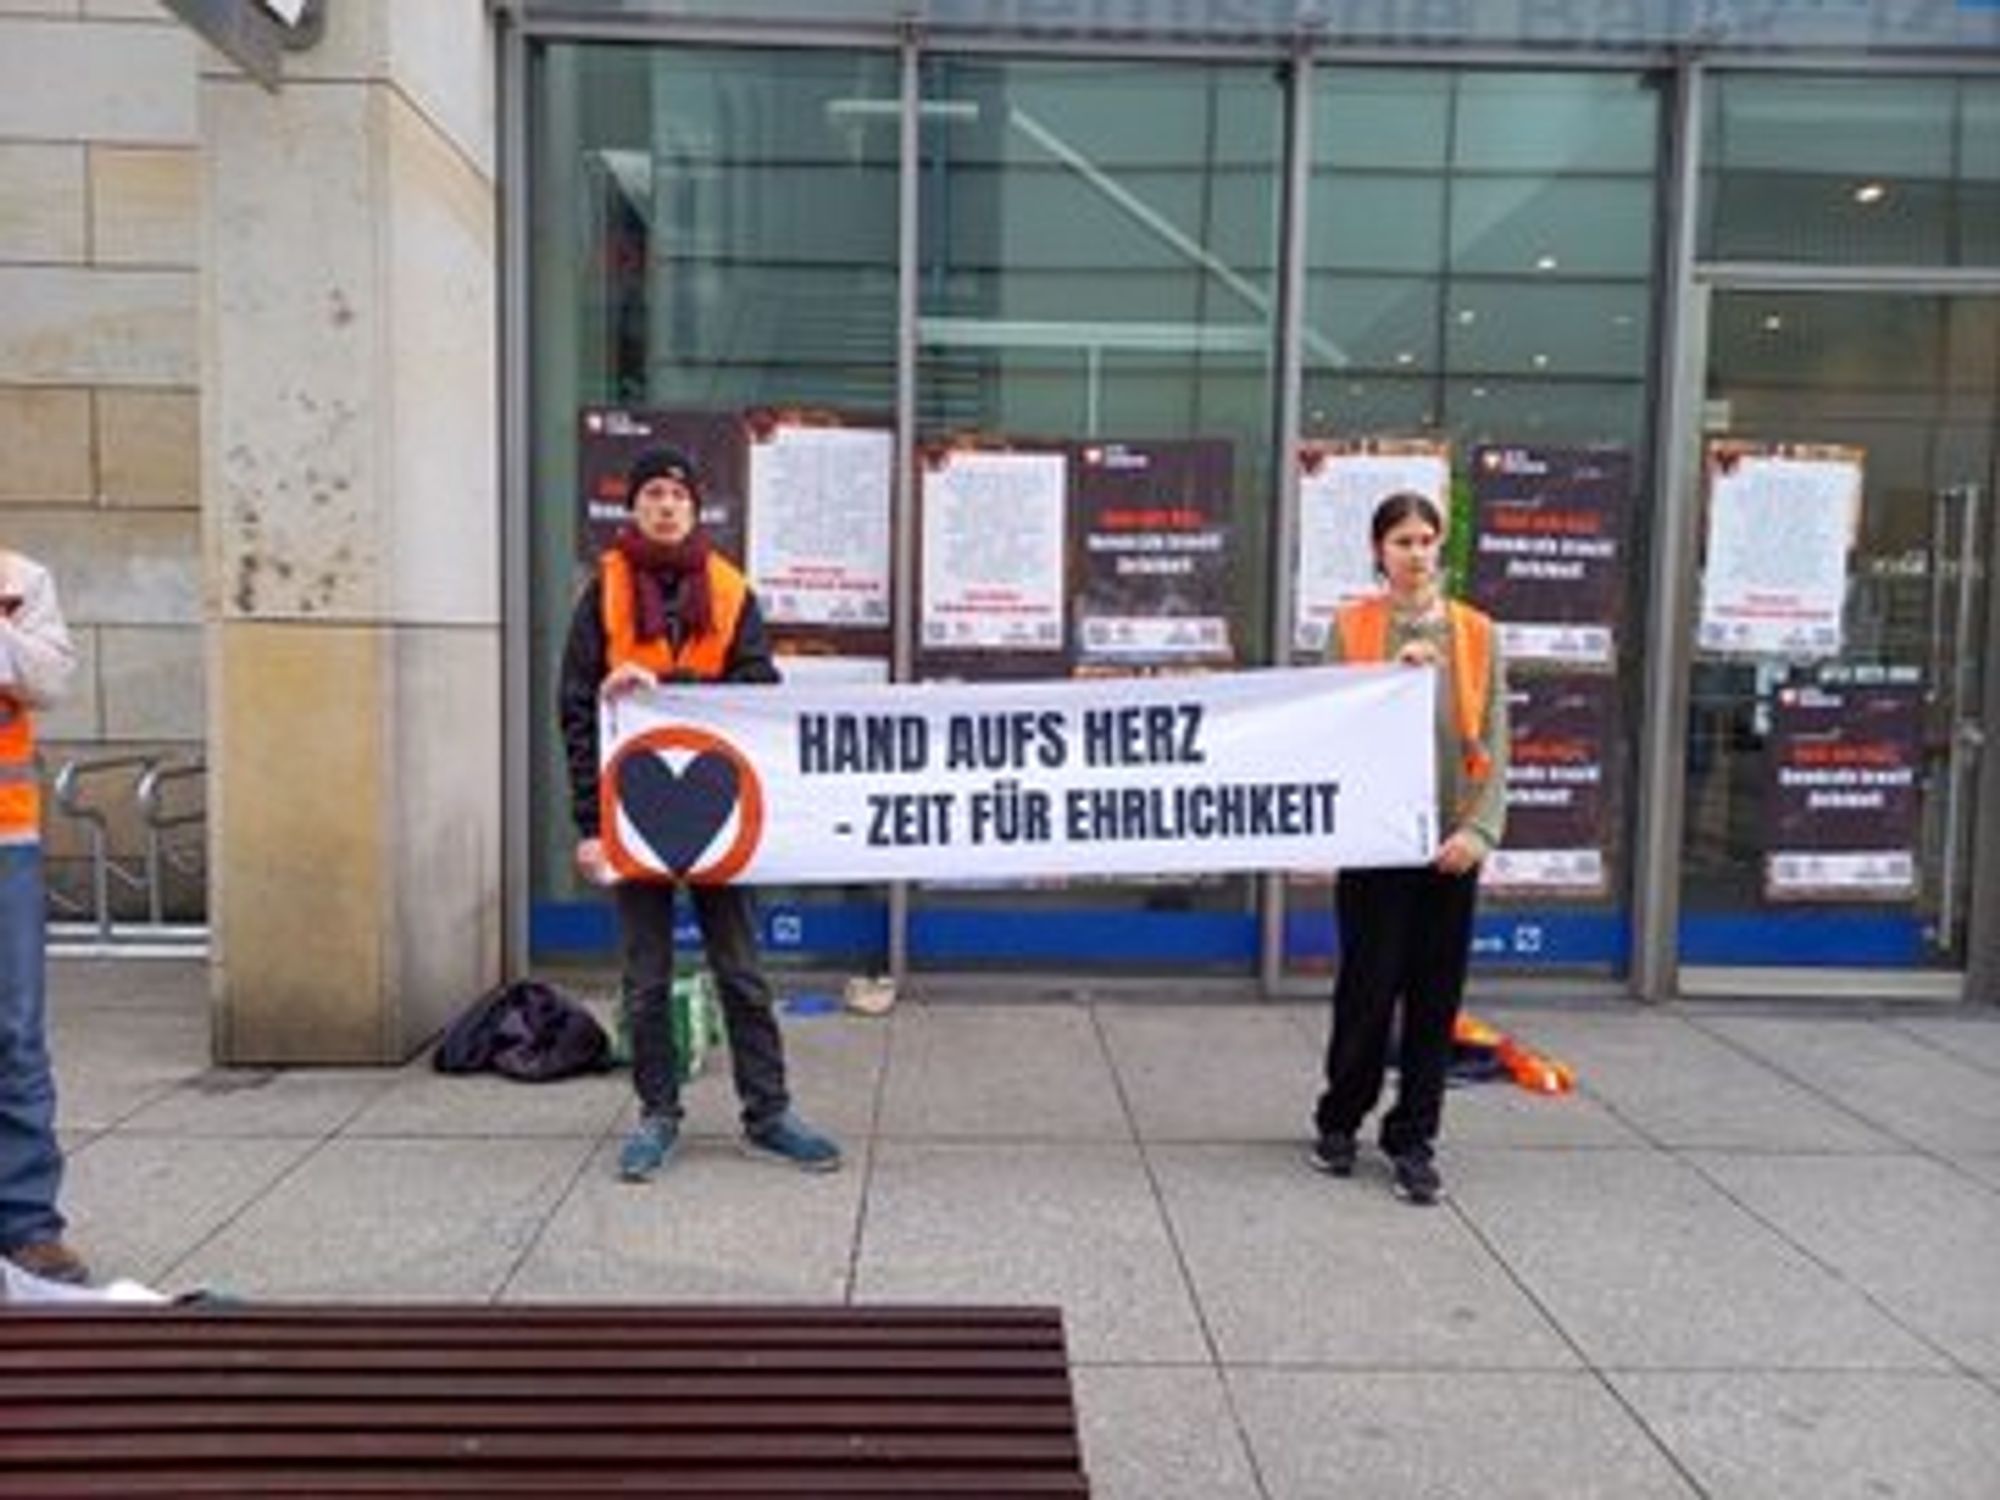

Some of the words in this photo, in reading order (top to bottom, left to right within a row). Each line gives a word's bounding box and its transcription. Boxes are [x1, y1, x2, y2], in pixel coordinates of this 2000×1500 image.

[798, 712, 929, 774] HAND
[946, 710, 1068, 770] AUFS
[1083, 704, 1206, 768] HERZ
[833, 822, 853, 834] -
[866, 793, 956, 846] ZEIT
[970, 778, 1052, 846] FÜR
[1065, 782, 1341, 841] EHRLICHKEIT
